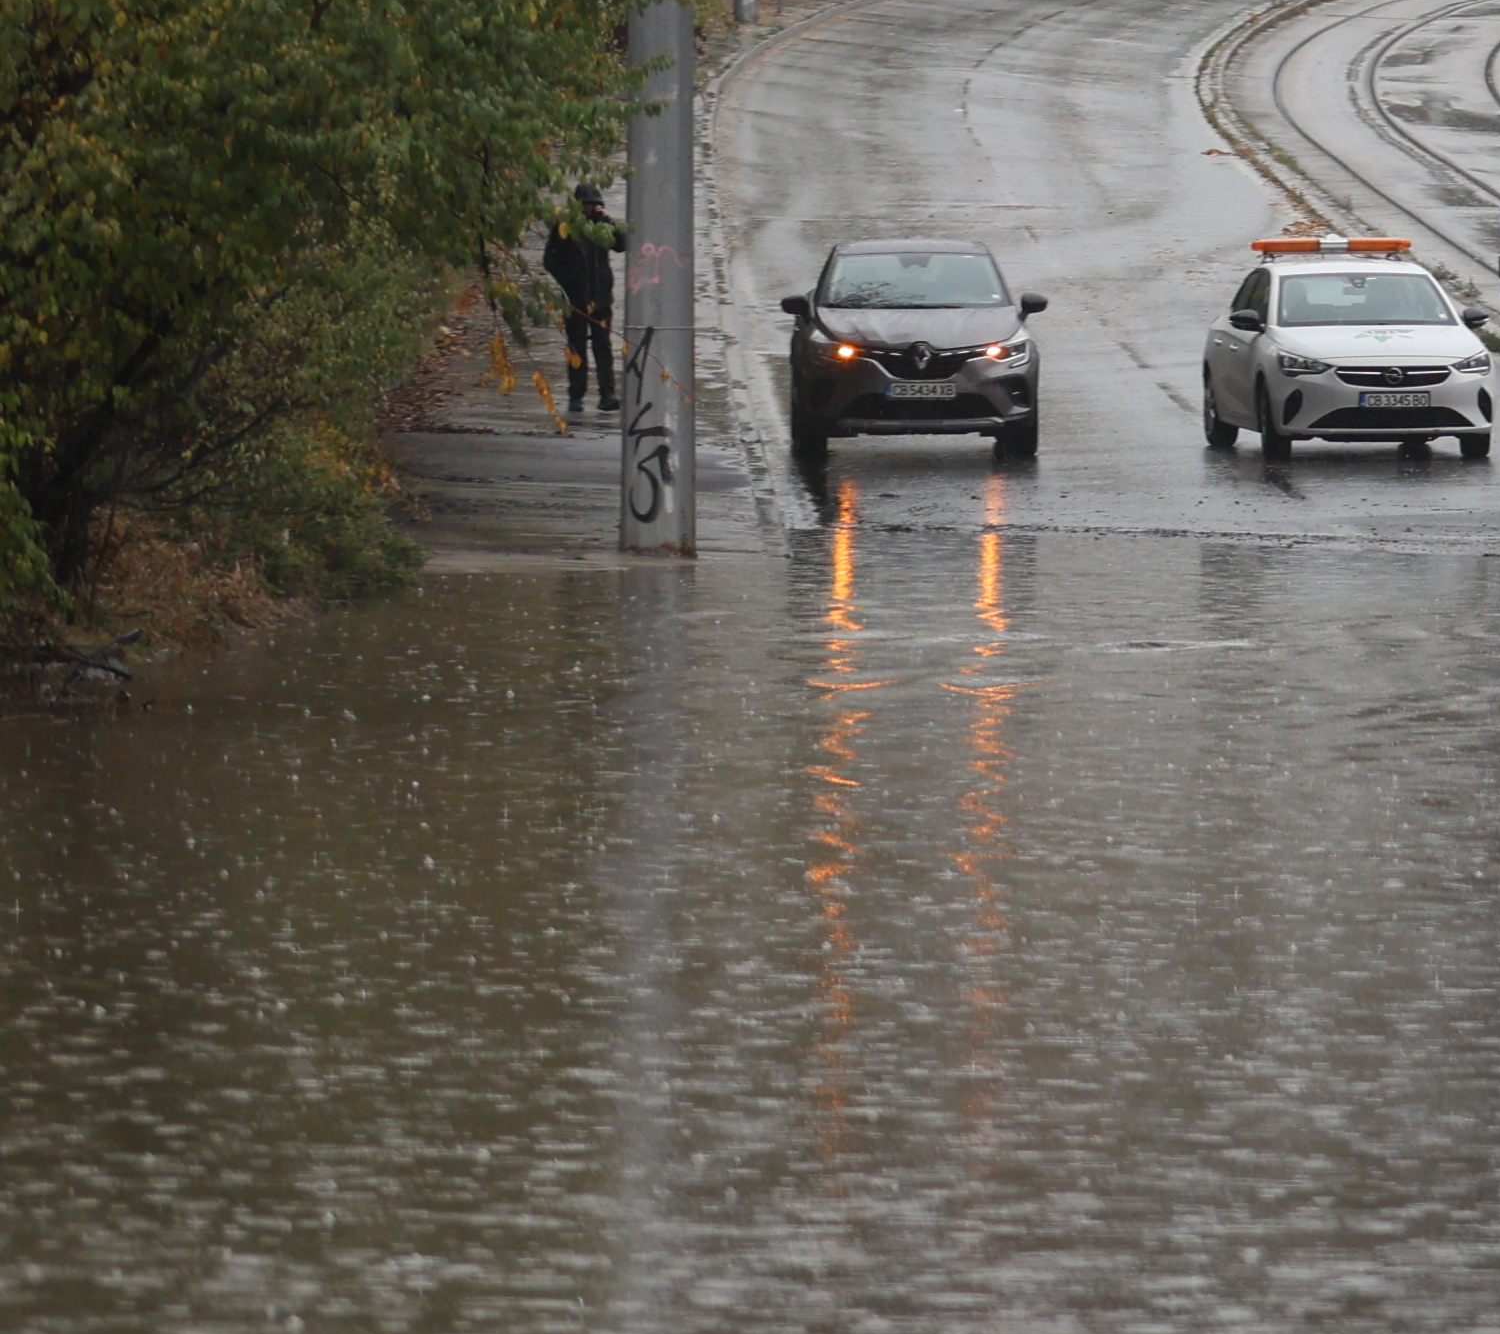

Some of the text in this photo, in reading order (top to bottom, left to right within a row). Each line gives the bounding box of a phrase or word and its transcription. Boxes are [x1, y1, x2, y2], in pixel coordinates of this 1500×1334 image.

[893, 384, 907, 396] CB
[909, 384, 936, 396] 5434
[1367, 395, 1382, 406] CB
[1384, 395, 1411, 406] 3345
